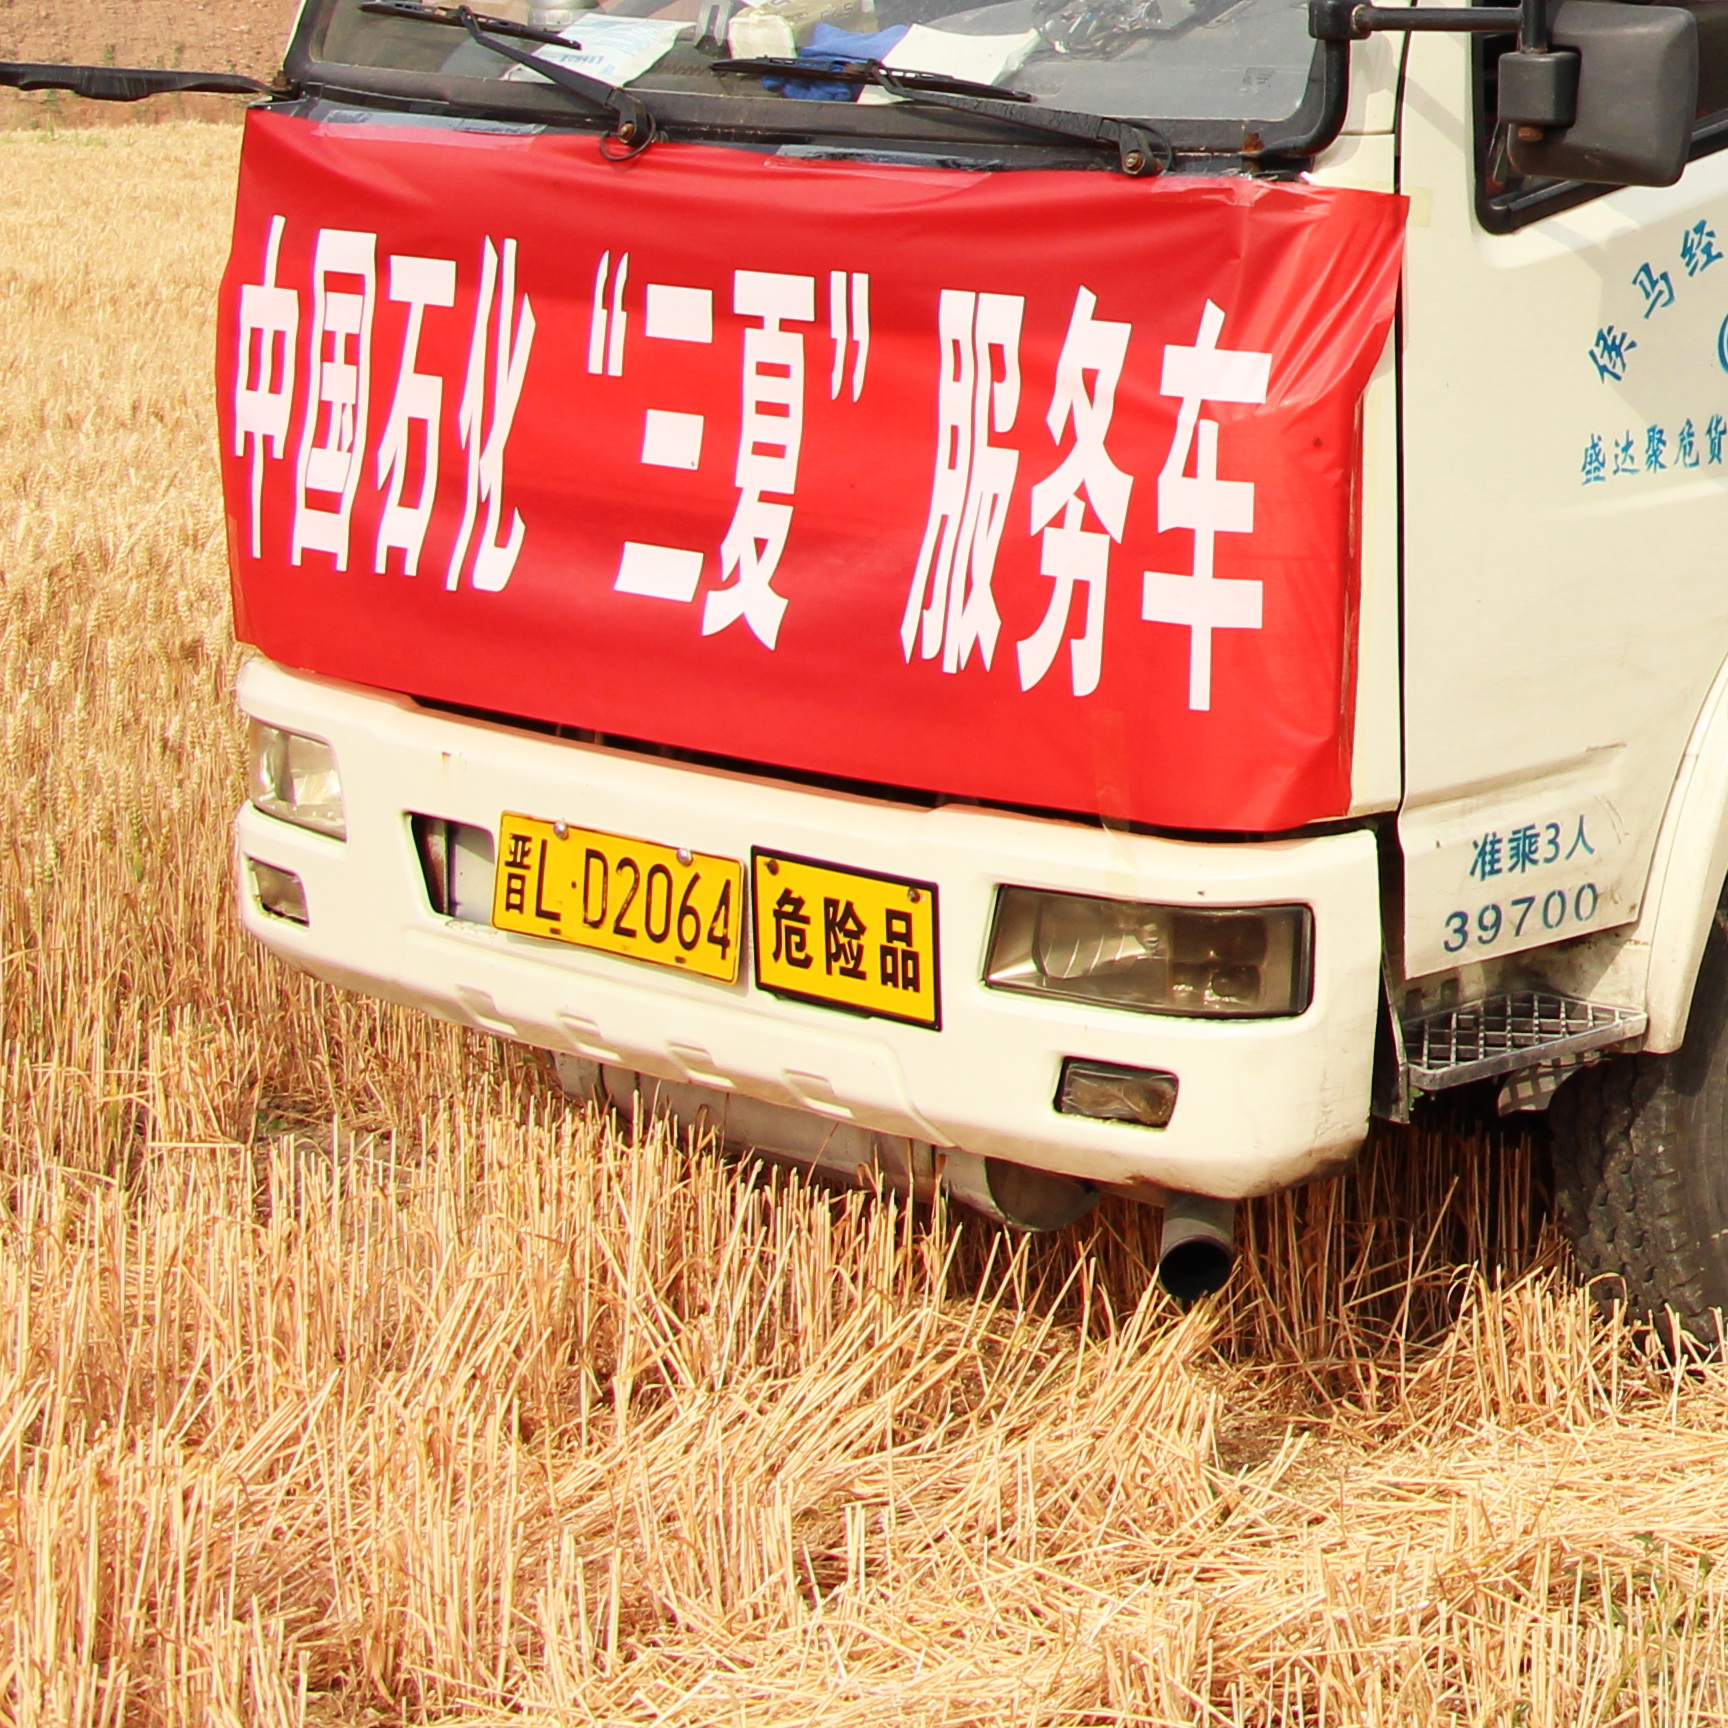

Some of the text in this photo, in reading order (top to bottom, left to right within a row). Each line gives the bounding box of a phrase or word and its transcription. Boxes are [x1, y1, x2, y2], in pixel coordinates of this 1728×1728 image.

[233, 215, 537, 592] 中国石化
[900, 285, 1273, 713] 服务车
[1470, 813, 1596, 883] 准乘3人
[771, 887, 921, 994] 危险品
[1443, 881, 1599, 954] 39700
